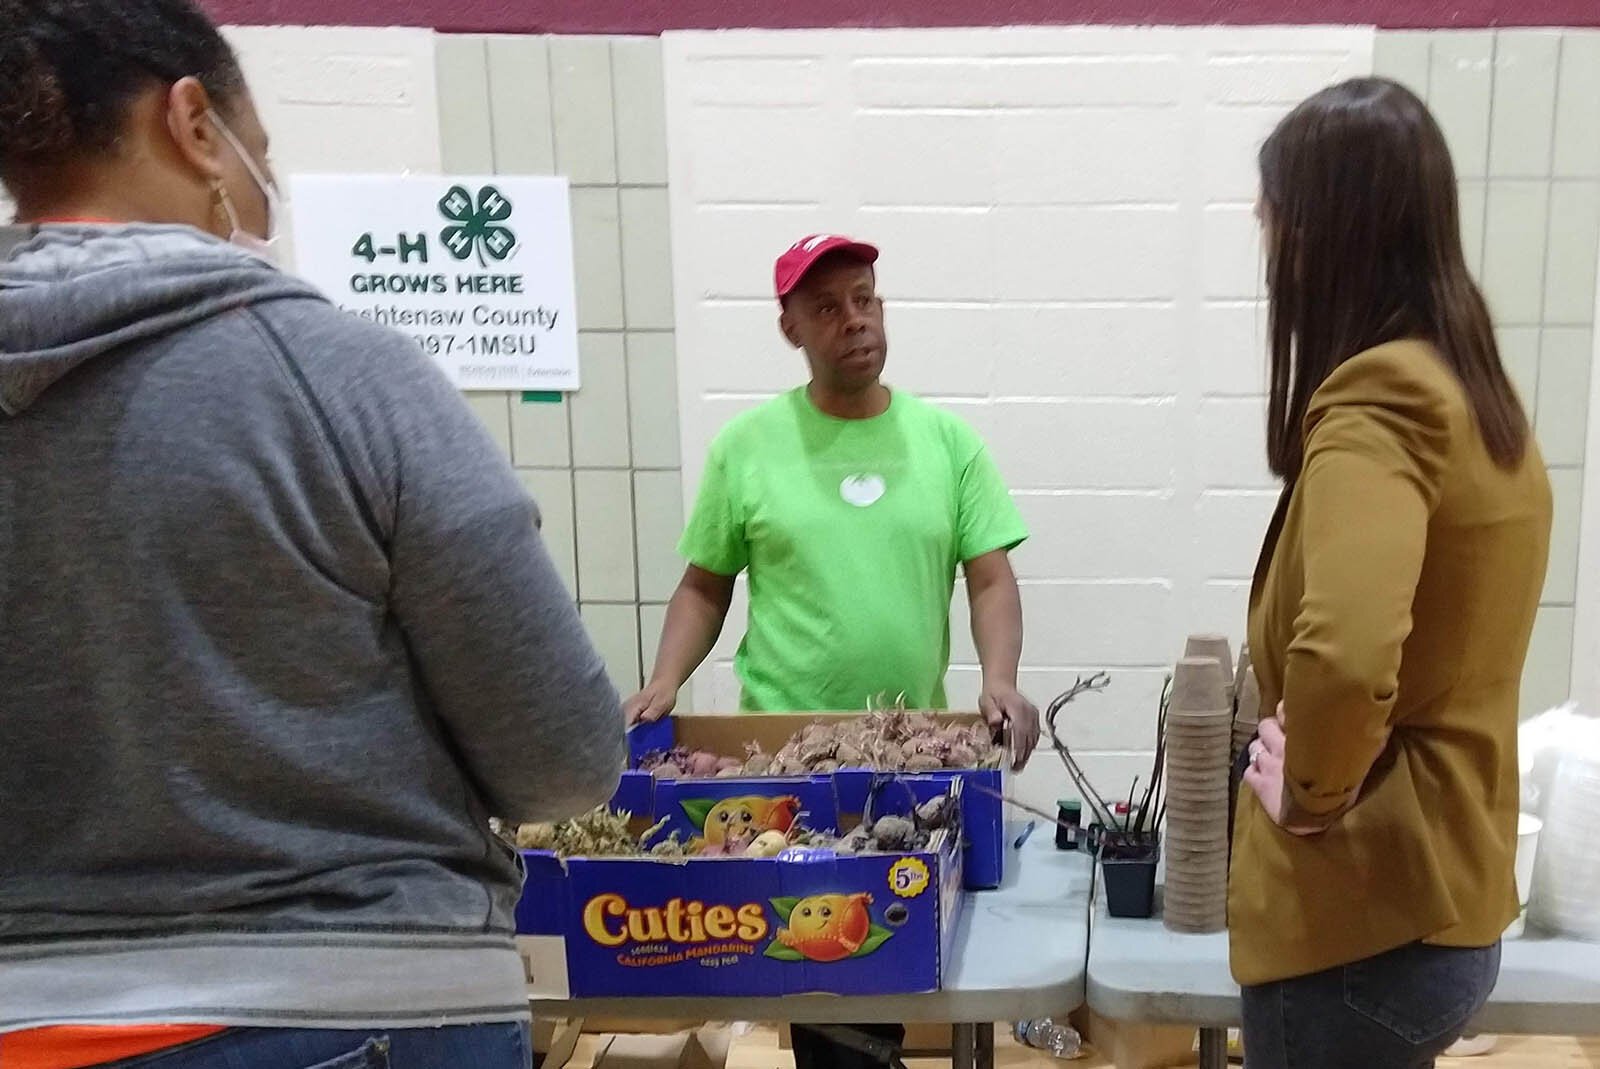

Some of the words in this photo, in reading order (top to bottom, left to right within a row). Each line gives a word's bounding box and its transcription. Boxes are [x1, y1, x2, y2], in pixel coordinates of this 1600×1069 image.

[351, 232, 428, 263] 4-H
[351, 274, 447, 293] GROWS
[456, 274, 523, 293] HERE
[473, 305, 558, 330] County
[584, 893, 767, 945] Cuties
[616, 953, 683, 967] CALIFORNIA
[685, 943, 754, 960] MANDARINS
